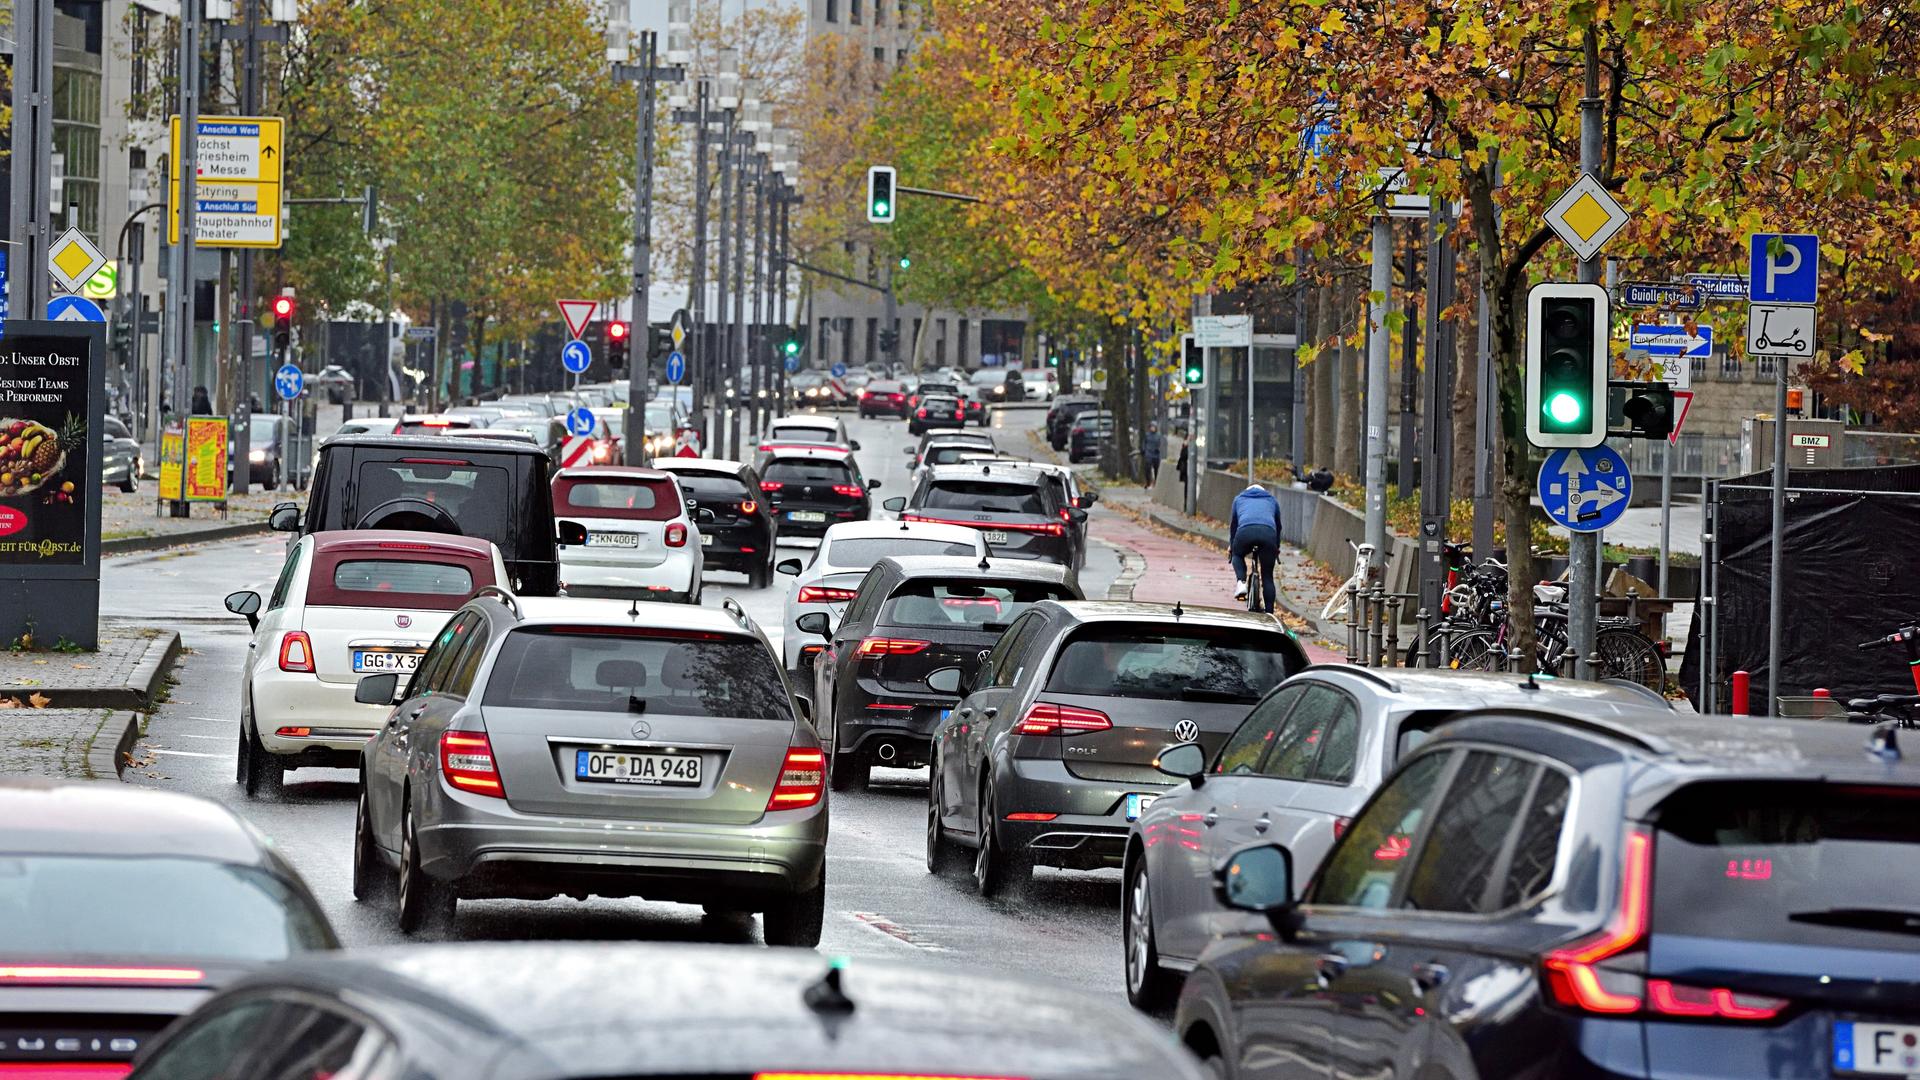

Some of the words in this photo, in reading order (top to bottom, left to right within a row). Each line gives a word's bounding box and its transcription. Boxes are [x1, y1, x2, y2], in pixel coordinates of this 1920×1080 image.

[202, 126, 237, 135] Anschluß
[240, 126, 259, 135] West
[196, 139, 231, 150] öchst
[196, 152, 250, 162] riesheim
[210, 164, 247, 175] Messe
[242, 202, 257, 212] Süd
[1766, 243, 1802, 294] P
[1801, 437, 1821, 445] BMZ
[18, 541, 38, 552] FÜR
[364, 654, 384, 668] GG
[394, 655, 404, 669] X
[1067, 746, 1098, 755] GOLF
[589, 755, 616, 775] OF
[629, 756, 656, 777] DA
[660, 758, 699, 780] 948
[1875, 1030, 1896, 1065] F
